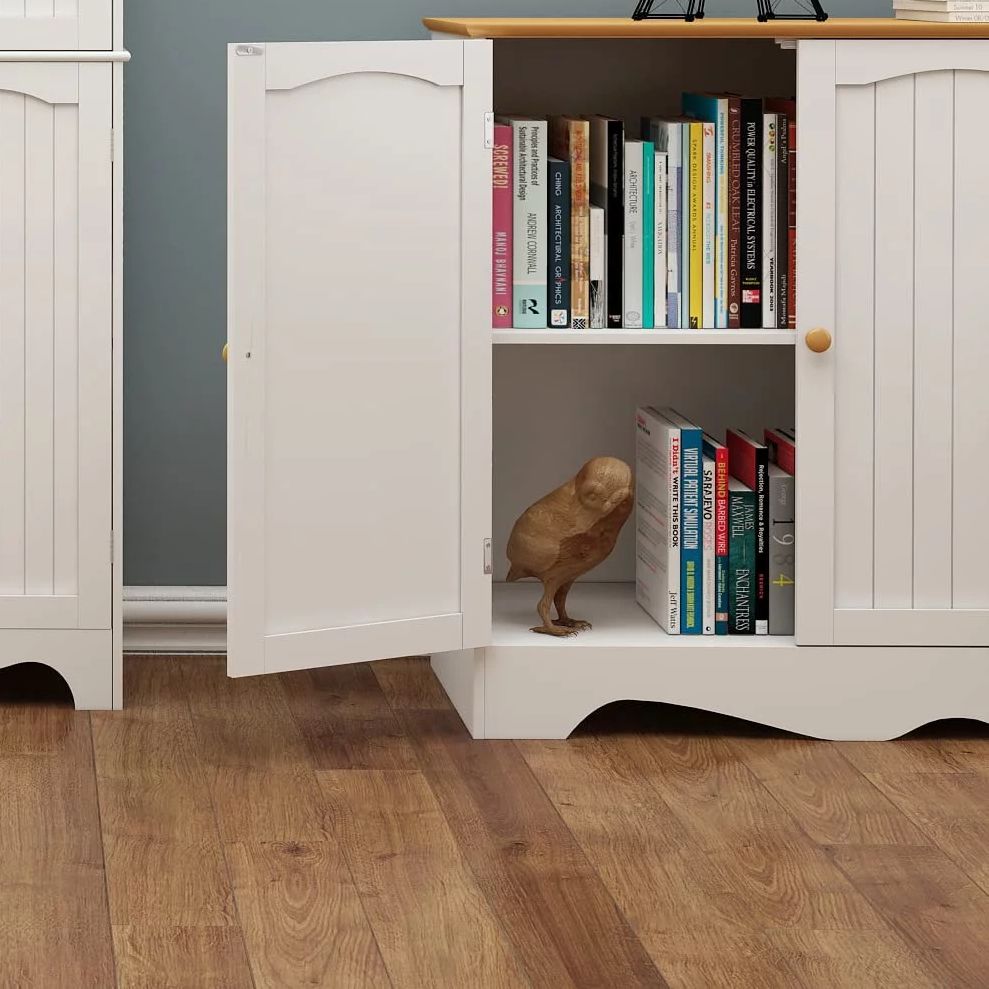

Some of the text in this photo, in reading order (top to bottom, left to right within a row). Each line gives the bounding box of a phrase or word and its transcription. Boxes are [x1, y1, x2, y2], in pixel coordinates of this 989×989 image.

[530, 126, 540, 150] Principles
[746, 122, 756, 147] POWER
[517, 126, 528, 201] Sustainable Architectural Design
[531, 150, 540, 158] and
[531, 158, 540, 180] Practices
[745, 149, 756, 182] QUALITY
[629, 170, 638, 214] ARCHITECTURE
[732, 119, 741, 233] CRUMBLED OAK LEAF
[746, 189, 756, 234] ELECTRICAL
[495, 231, 507, 256] MANOJ
[527, 212, 537, 275] ANDREW CORNWALL
[746, 235, 756, 270] SYSTEMS
[730, 269, 738, 297] Gavros
[683, 448, 698, 478] VIRTUAL
[683, 479, 698, 507] PATIENT
[703, 470, 712, 520] SARAJEVO
[717, 462, 726, 498] BEHIND
[683, 508, 698, 549] SIMULATION
[717, 499, 726, 532] BARBED
[731, 496, 745, 538] MAXWELL
[744, 504, 754, 530] JAMES
[717, 533, 726, 553] WIRE
[757, 527, 765, 553] Royalties
[669, 591, 677, 607] Jeff
[735, 569, 750, 631] ENCHANTRESS
